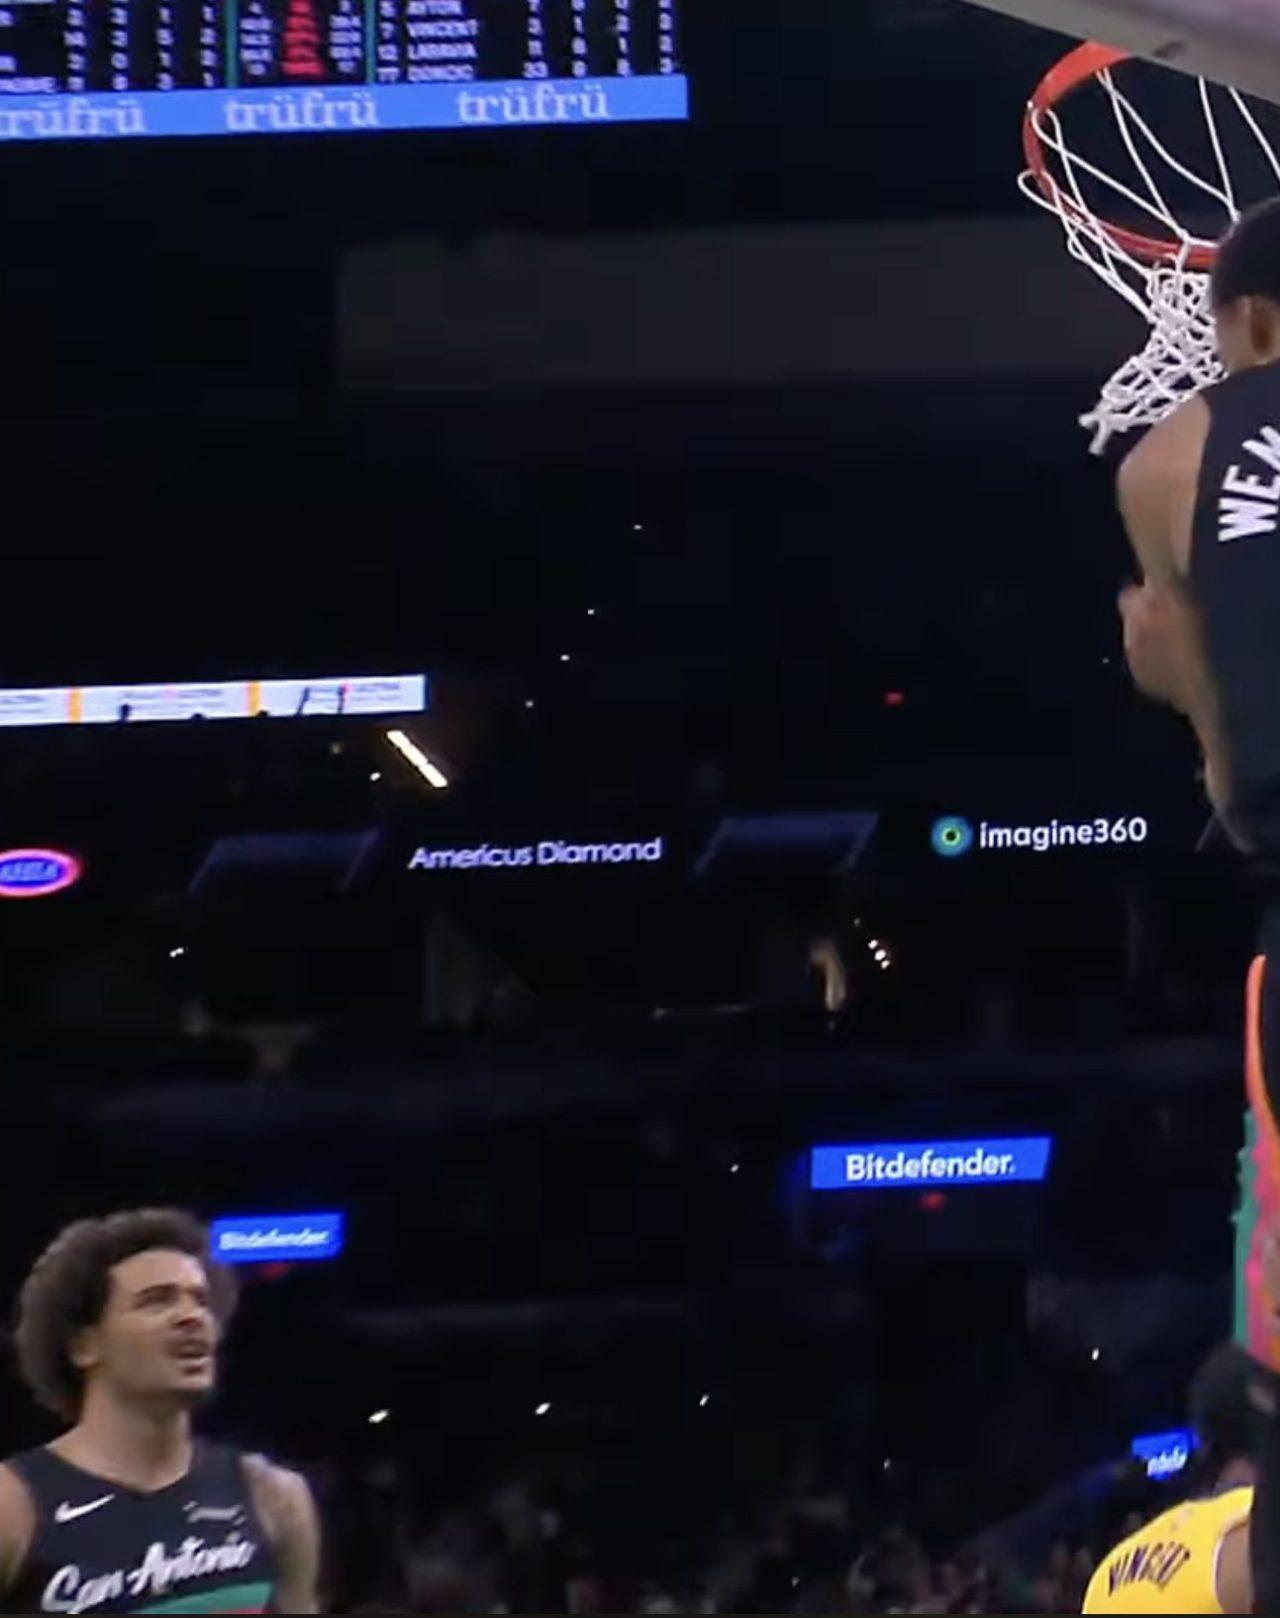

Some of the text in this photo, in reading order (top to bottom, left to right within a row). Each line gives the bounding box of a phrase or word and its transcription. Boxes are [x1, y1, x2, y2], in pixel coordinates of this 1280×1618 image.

[224, 92, 379, 132] trüfrü
[456, 82, 612, 123] trüfrü
[407, 837, 662, 869] Americus Diamond
[979, 816, 1148, 851] imagine360
[127, 1536, 257, 1597] Antonio
